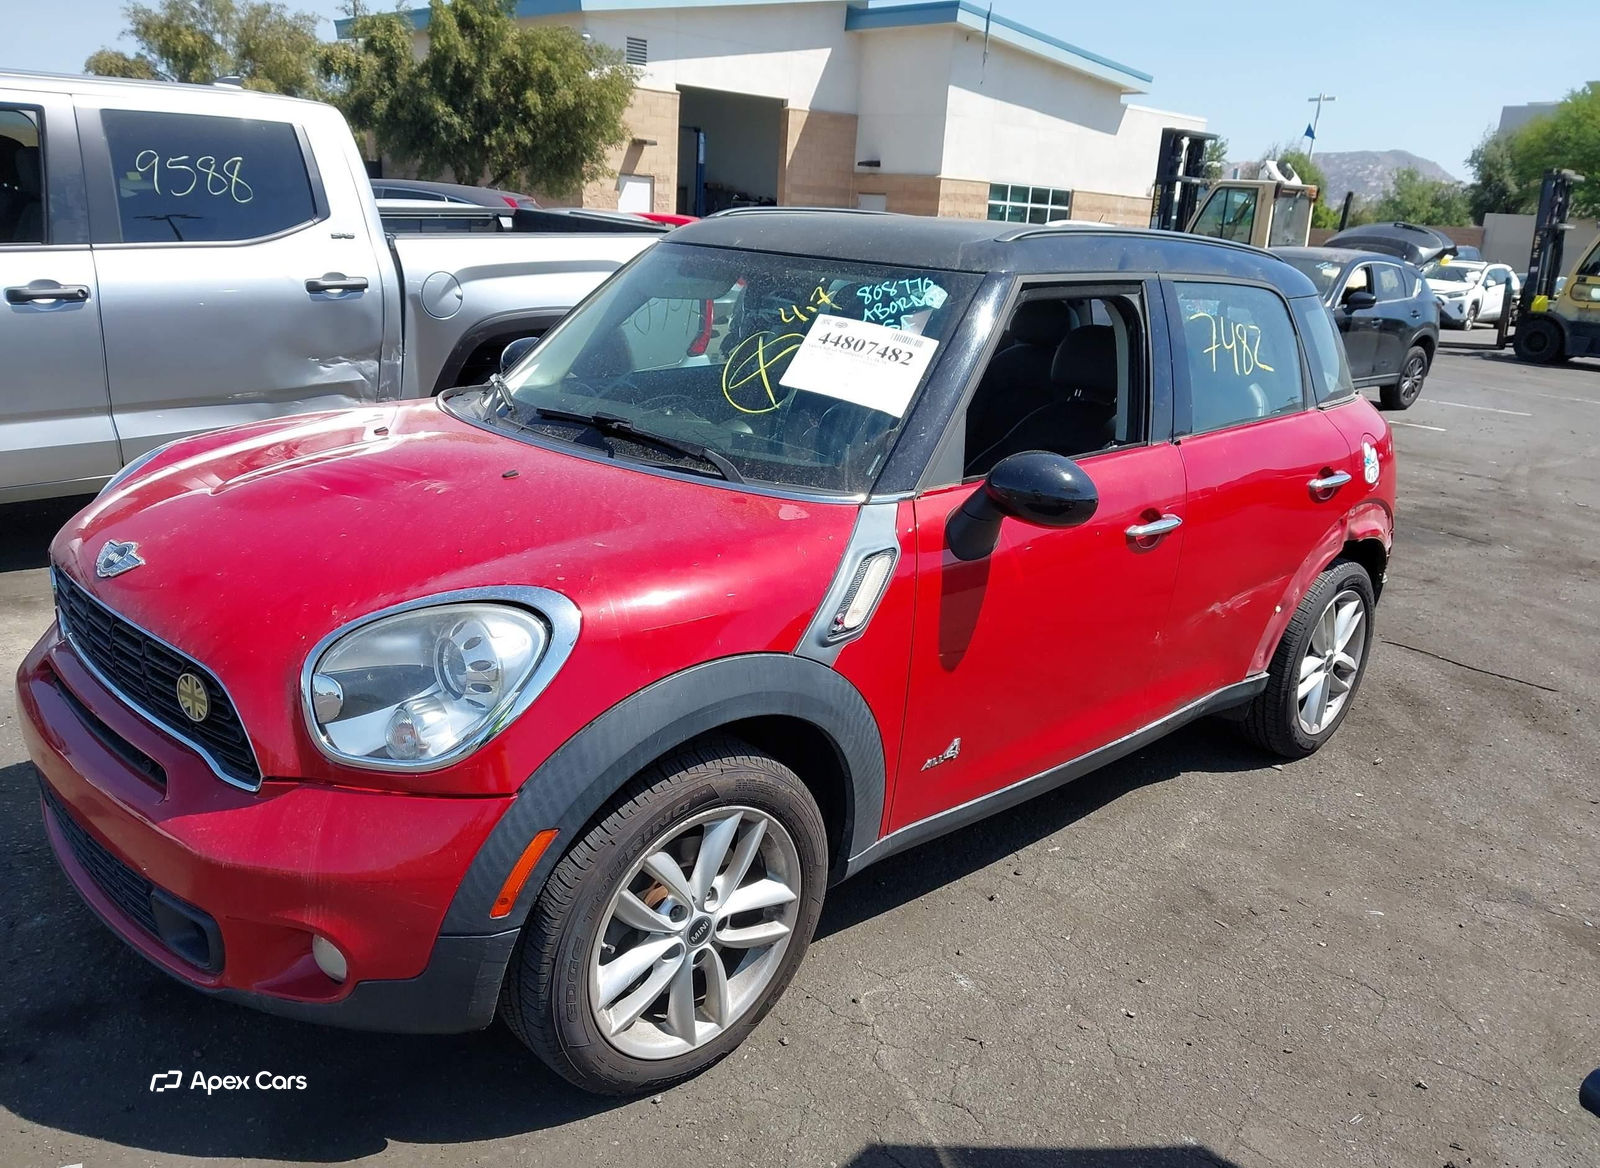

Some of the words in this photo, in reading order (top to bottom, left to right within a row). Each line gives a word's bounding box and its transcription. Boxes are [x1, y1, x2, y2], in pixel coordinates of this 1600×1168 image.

[135, 149, 254, 203] 9588
[818, 332, 914, 366] 44807482
[1188, 312, 1275, 376] 7482
[690, 921, 709, 943] MINI
